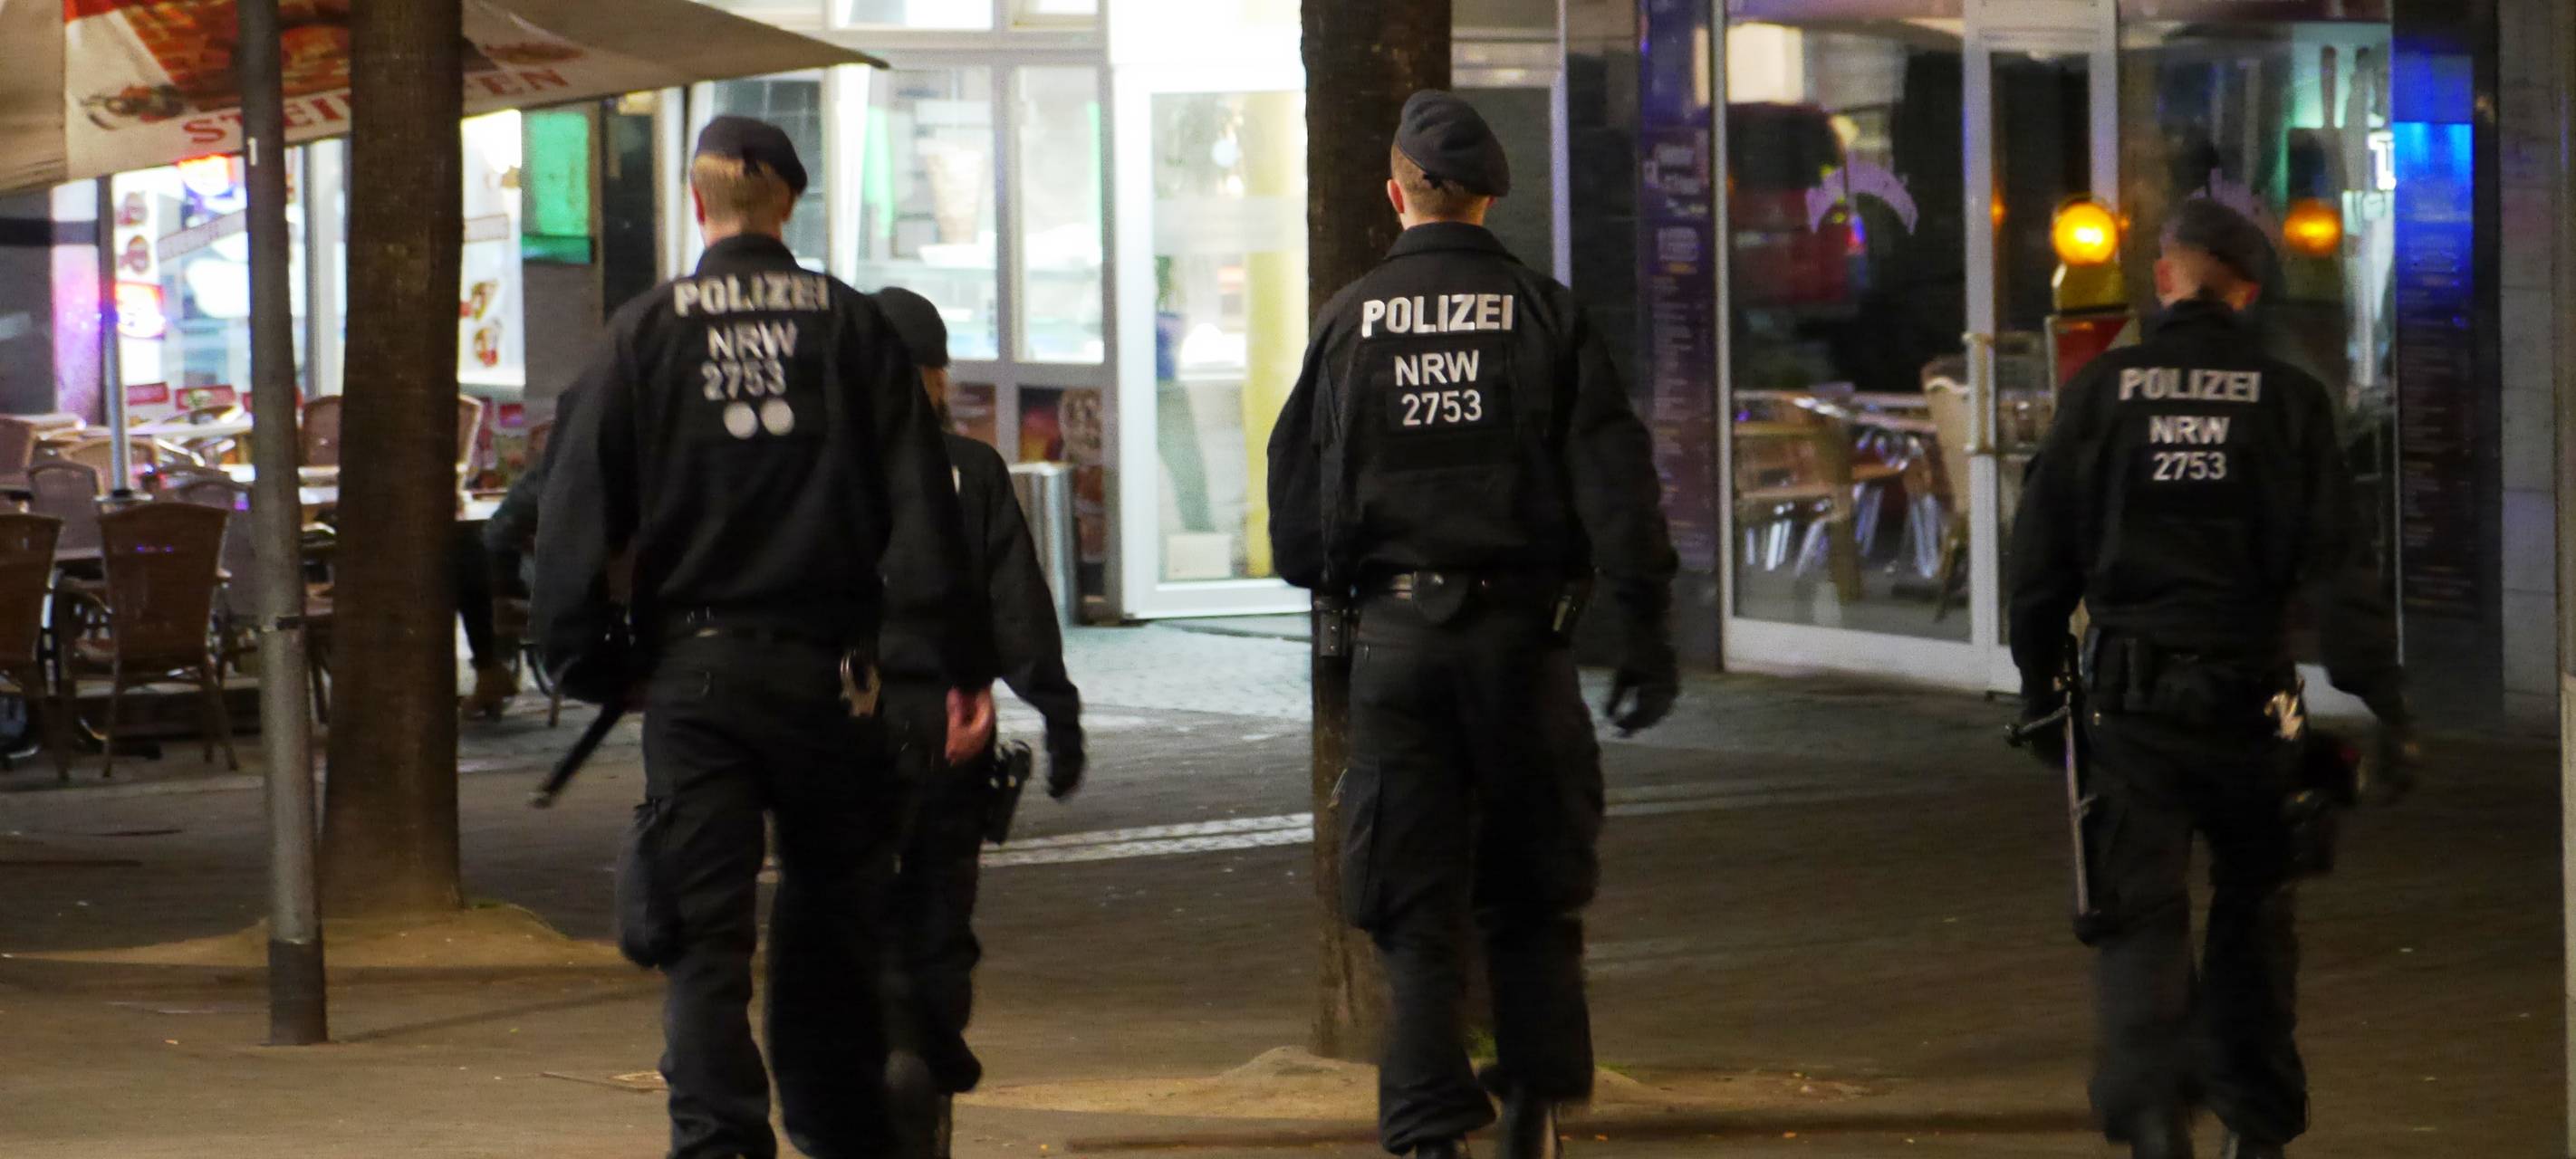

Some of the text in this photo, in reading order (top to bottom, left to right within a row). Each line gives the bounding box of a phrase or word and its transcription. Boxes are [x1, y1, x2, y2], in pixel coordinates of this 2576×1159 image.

[674, 273, 830, 316] POLIZEI
[1361, 293, 1514, 338] POLIZEI
[707, 319, 798, 360] NRW
[701, 359, 787, 400] 2753
[1394, 350, 1479, 387] NRW
[2119, 367, 2262, 403] POLIZEI
[1401, 388, 1482, 426] 2753
[2148, 415, 2231, 445] NRW
[2152, 451, 2227, 481] 2753
